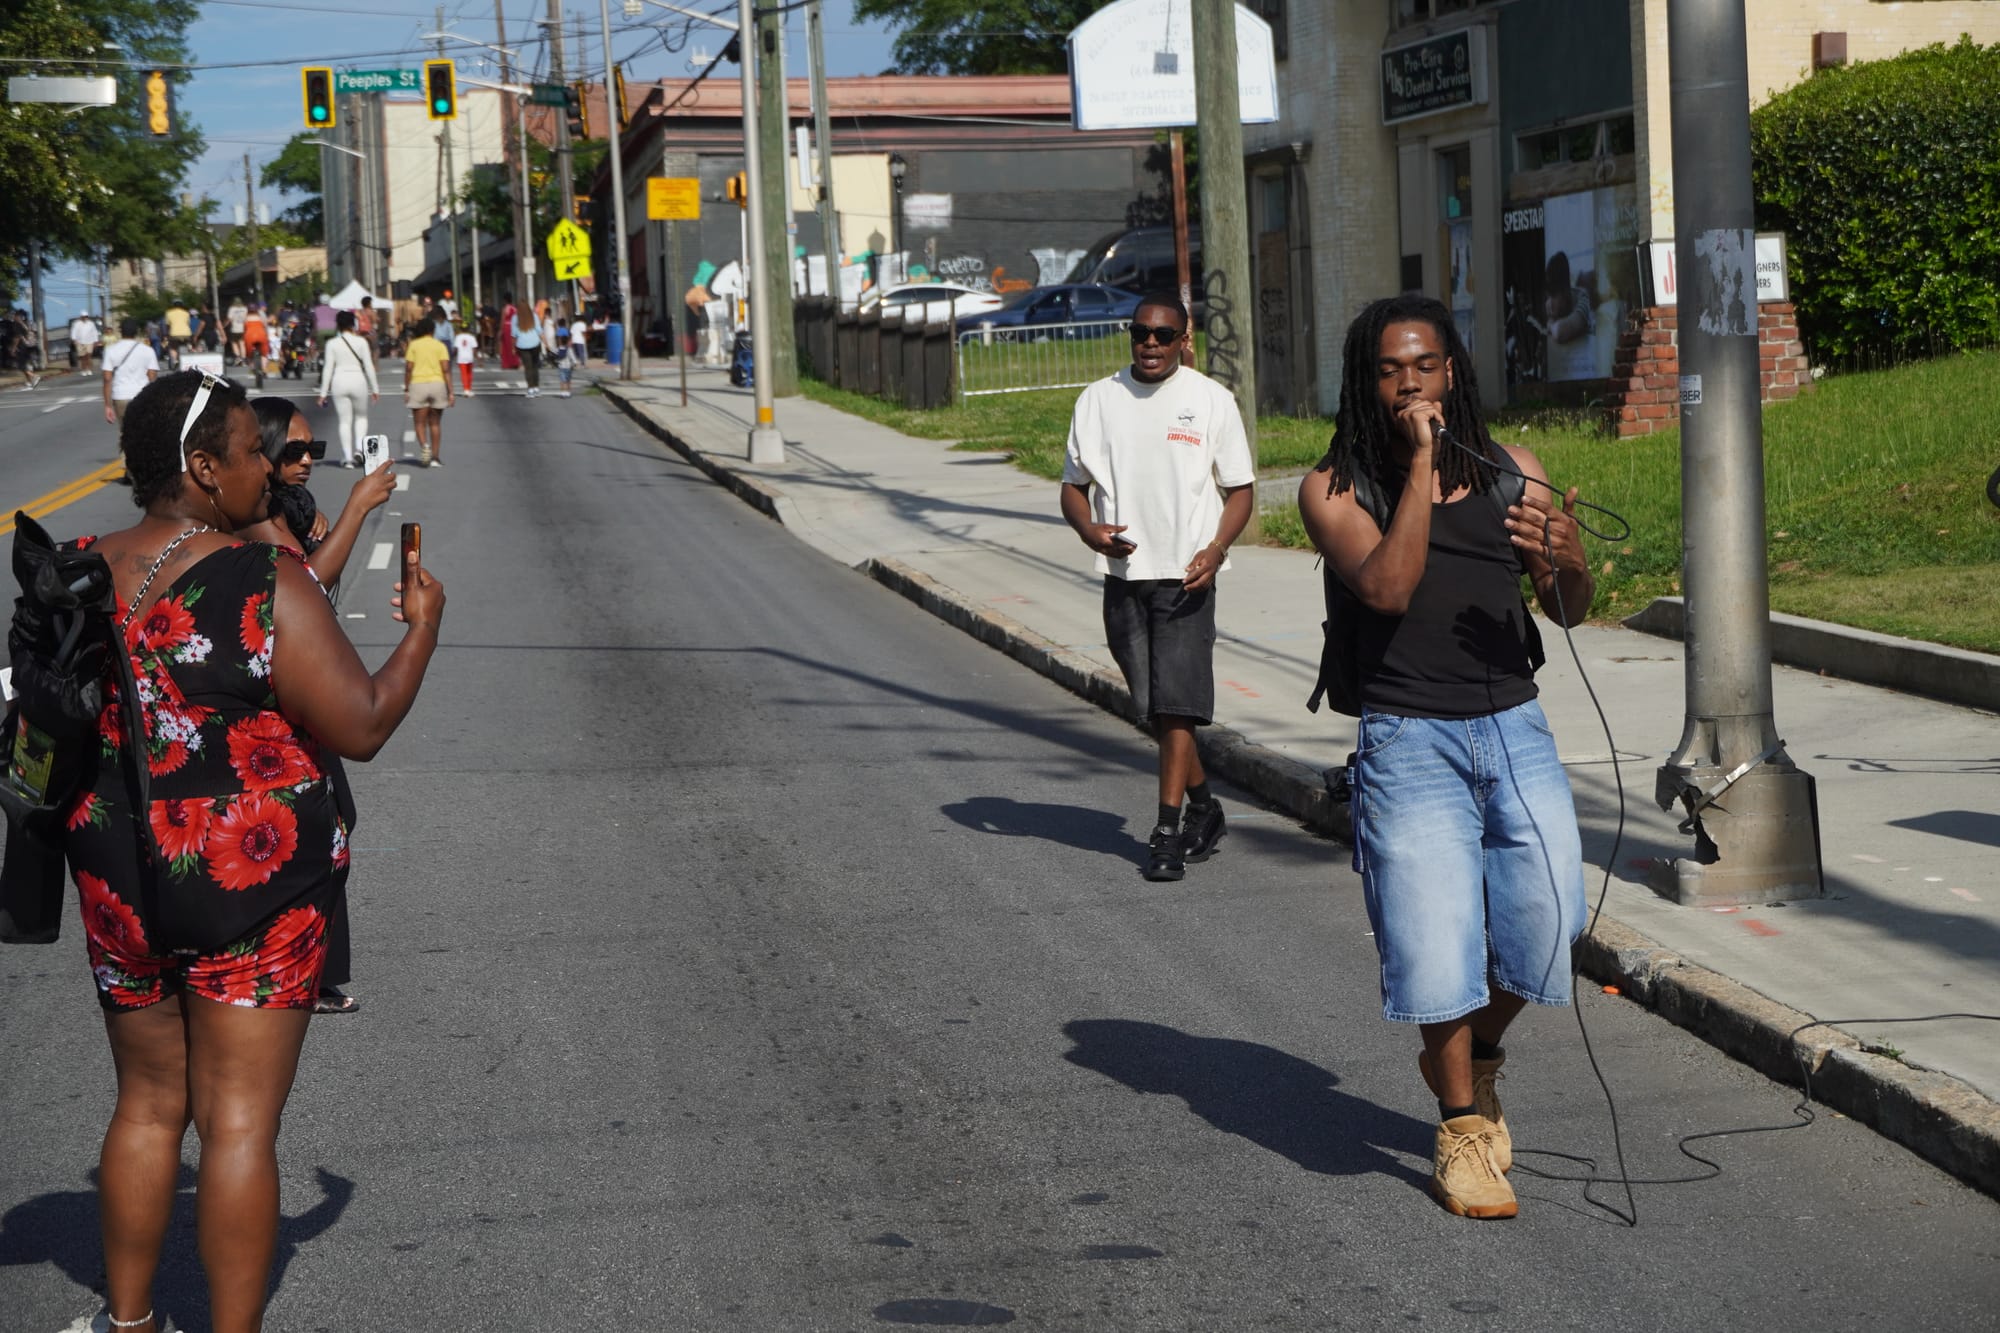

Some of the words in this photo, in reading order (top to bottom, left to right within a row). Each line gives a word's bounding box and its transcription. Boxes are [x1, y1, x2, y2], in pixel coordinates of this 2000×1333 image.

[1404, 47, 1443, 73] Pro-Care
[339, 73, 392, 90] Peeples
[399, 72, 416, 86] St
[1405, 72, 1434, 98] Dental
[1436, 68, 1470, 91] Services
[1756, 261, 1780, 273] GNERS
[1680, 390, 1701, 402] BER
